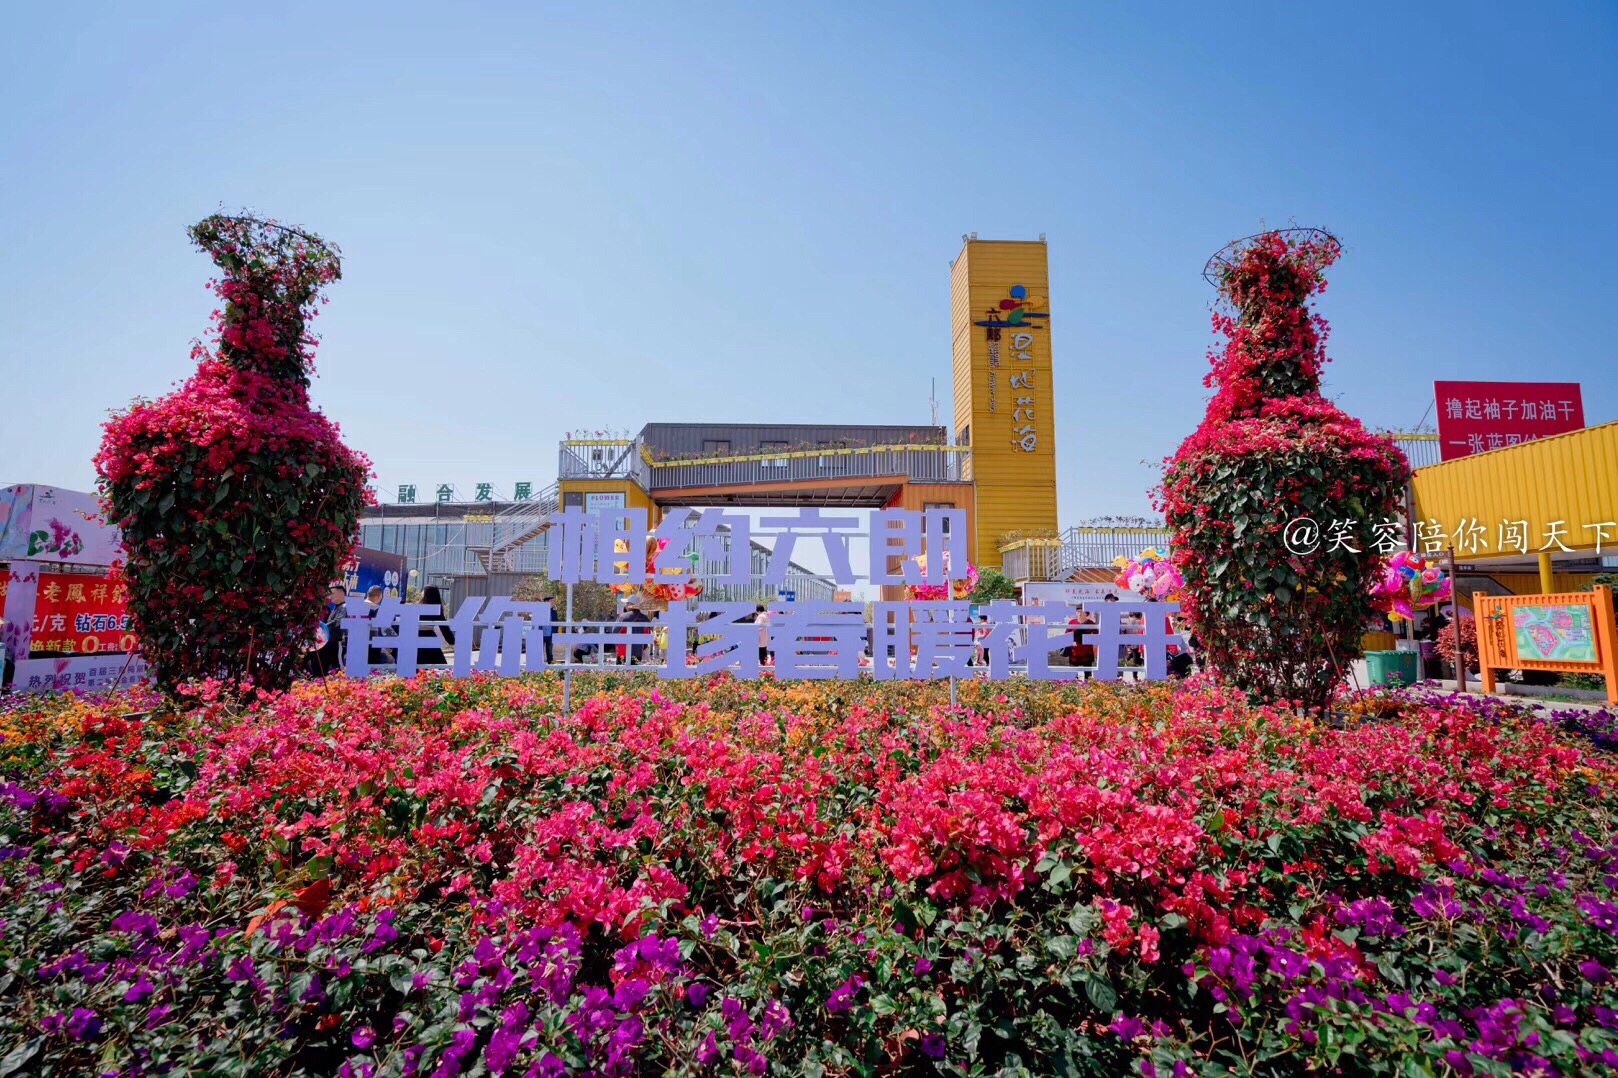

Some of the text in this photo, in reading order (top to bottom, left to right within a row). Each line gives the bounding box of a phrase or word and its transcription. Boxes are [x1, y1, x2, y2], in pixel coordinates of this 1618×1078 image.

[1445, 397, 1575, 421] 撸起袖子加油干
[398, 482, 531, 504] 融合发展
[75, 613, 135, 633] 钻石6.5
